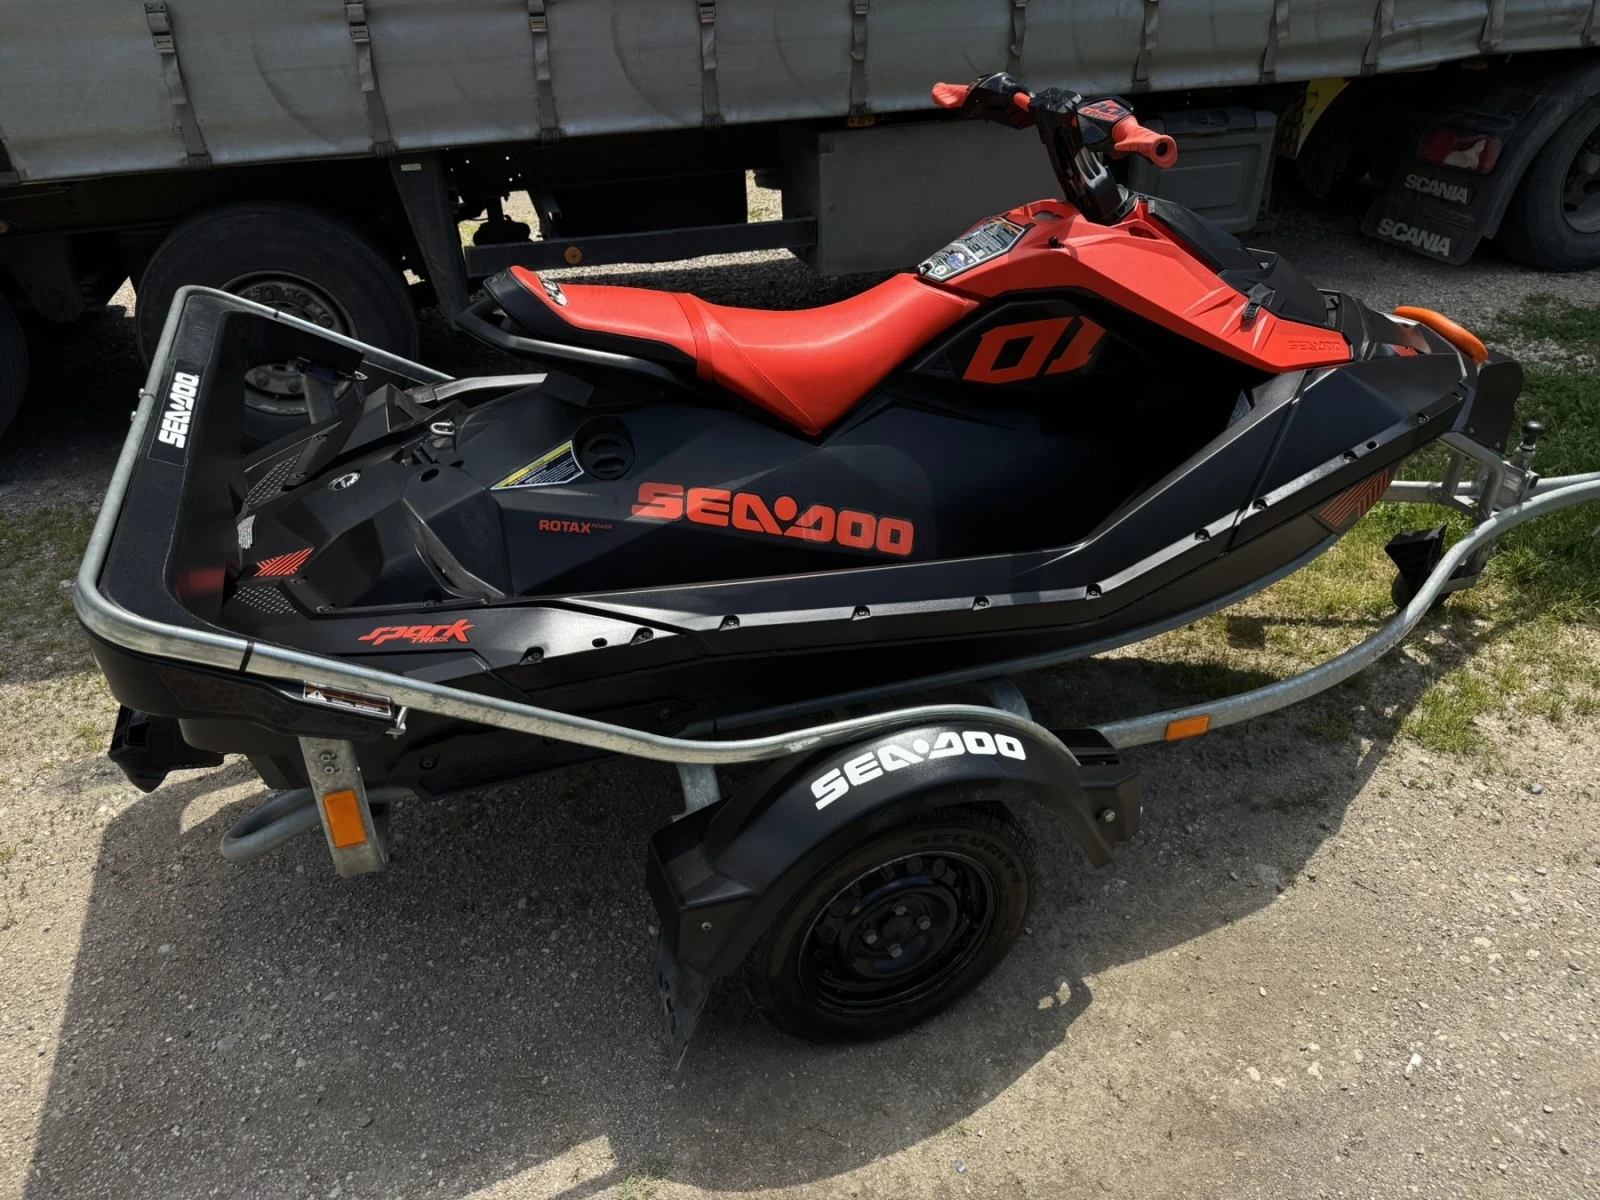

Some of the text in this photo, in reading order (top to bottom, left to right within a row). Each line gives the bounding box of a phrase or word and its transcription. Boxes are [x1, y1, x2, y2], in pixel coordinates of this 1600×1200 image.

[1403, 173, 1468, 205] SCANIA
[1377, 217, 1451, 257] SCANIA
[962, 315, 1107, 385] 01
[538, 519, 591, 534] ROTAX
